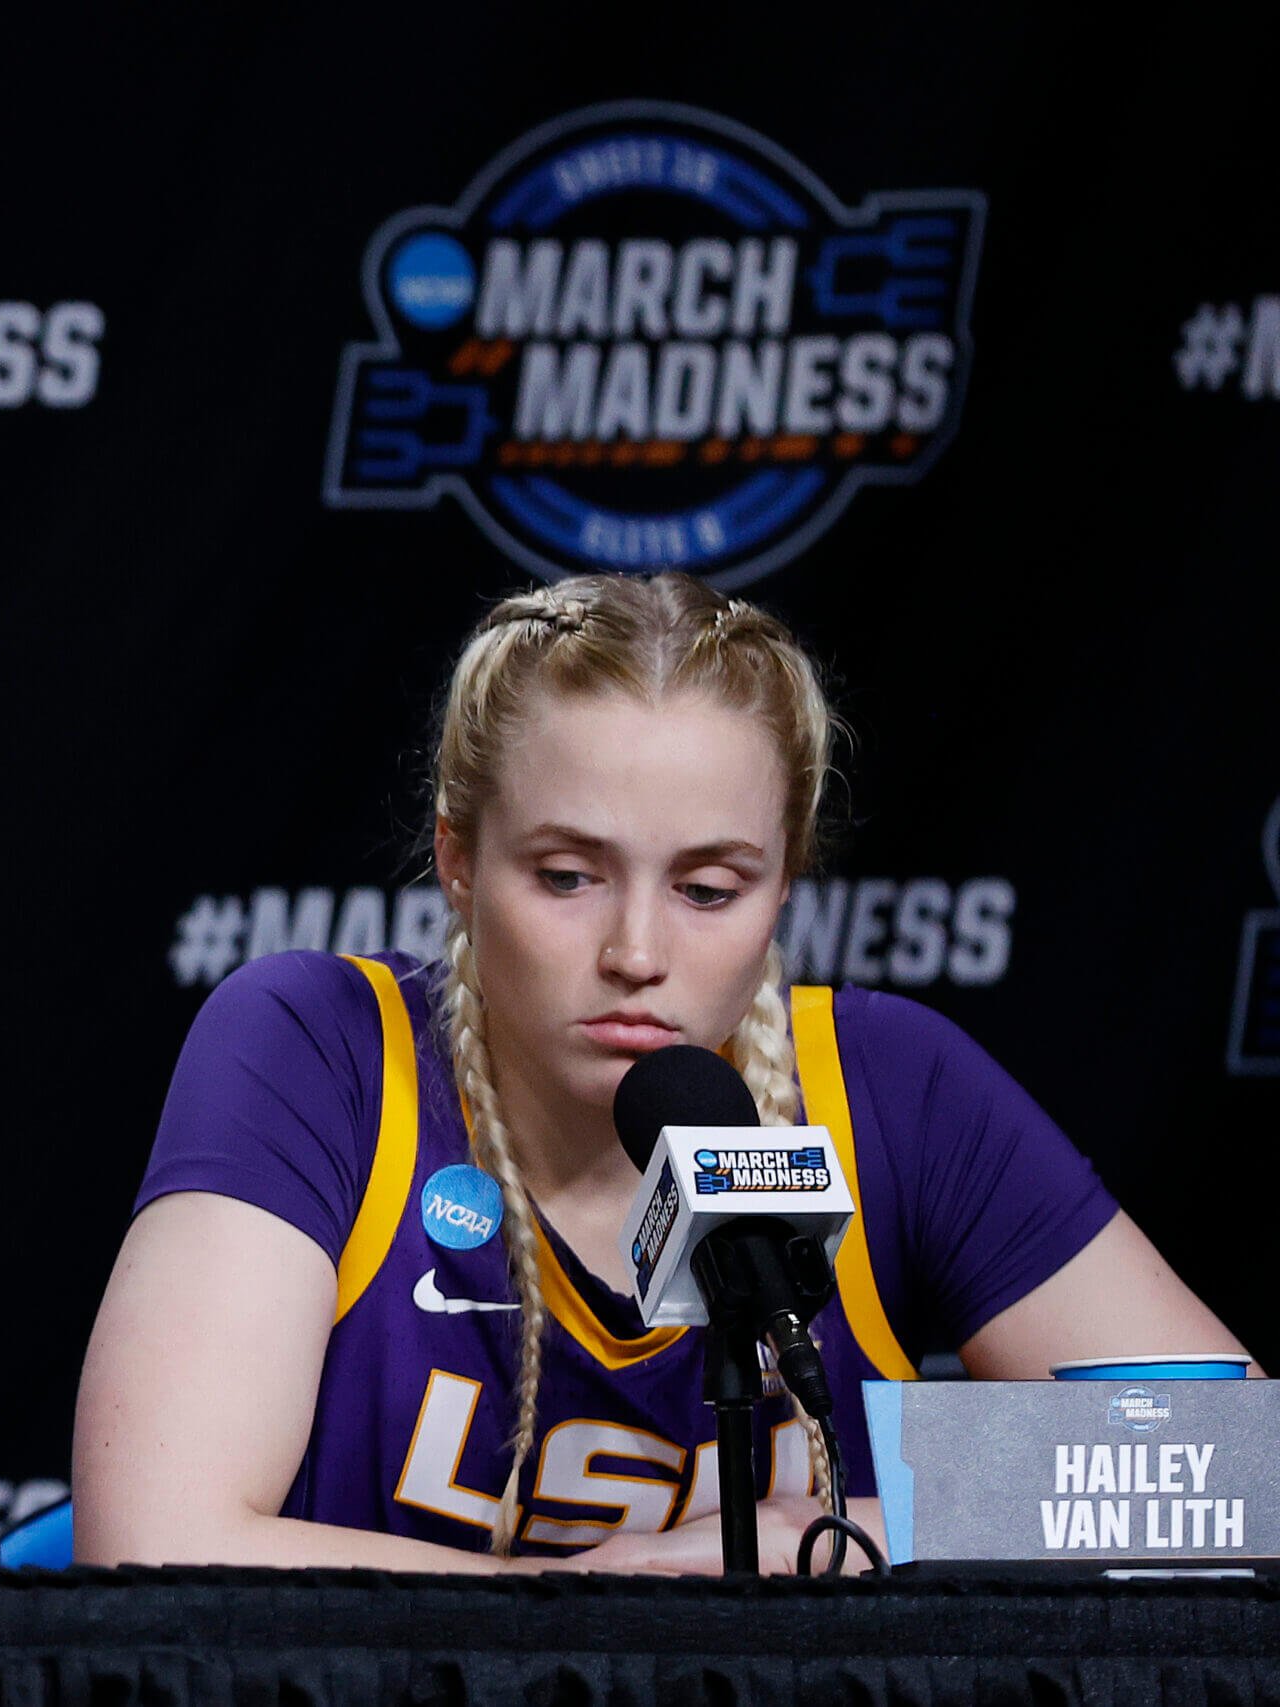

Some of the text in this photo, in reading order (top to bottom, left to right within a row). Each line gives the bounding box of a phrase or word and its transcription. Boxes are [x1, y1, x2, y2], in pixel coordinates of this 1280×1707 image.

[474, 237, 799, 338] MARCH
[514, 332, 956, 441] MADNESS
[718, 1151, 789, 1169] MARCH
[732, 1168, 829, 1187] MADNESS
[426, 1194, 494, 1239] NCAA
[638, 1188, 663, 1254] MARCH
[646, 1182, 678, 1264] MADNESS
[1055, 1443, 1216, 1494] HAILEY
[1039, 1498, 1245, 1549] VAN LITH
